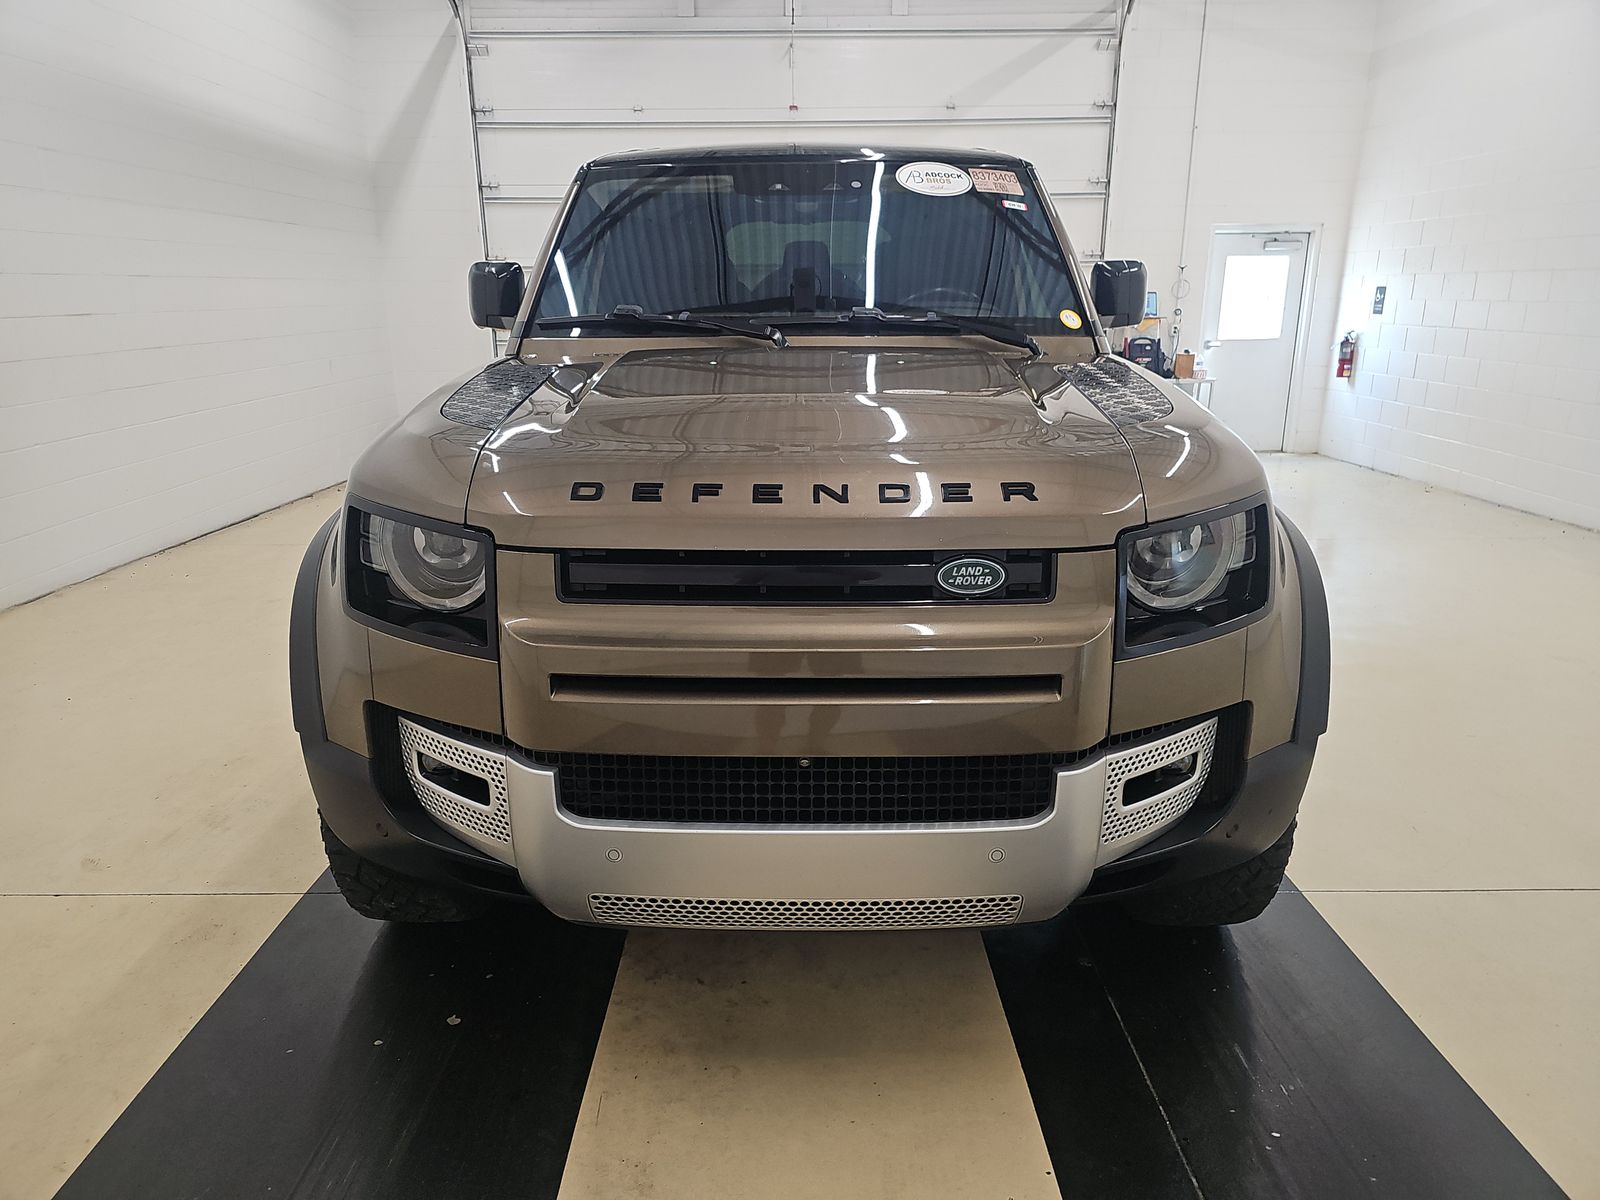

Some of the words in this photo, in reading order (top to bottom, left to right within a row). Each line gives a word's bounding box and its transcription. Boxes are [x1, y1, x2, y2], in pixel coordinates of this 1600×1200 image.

[925, 171, 964, 180] ADCOCK
[971, 170, 1018, 184] 8373403
[569, 481, 1039, 504] DEFENDER
